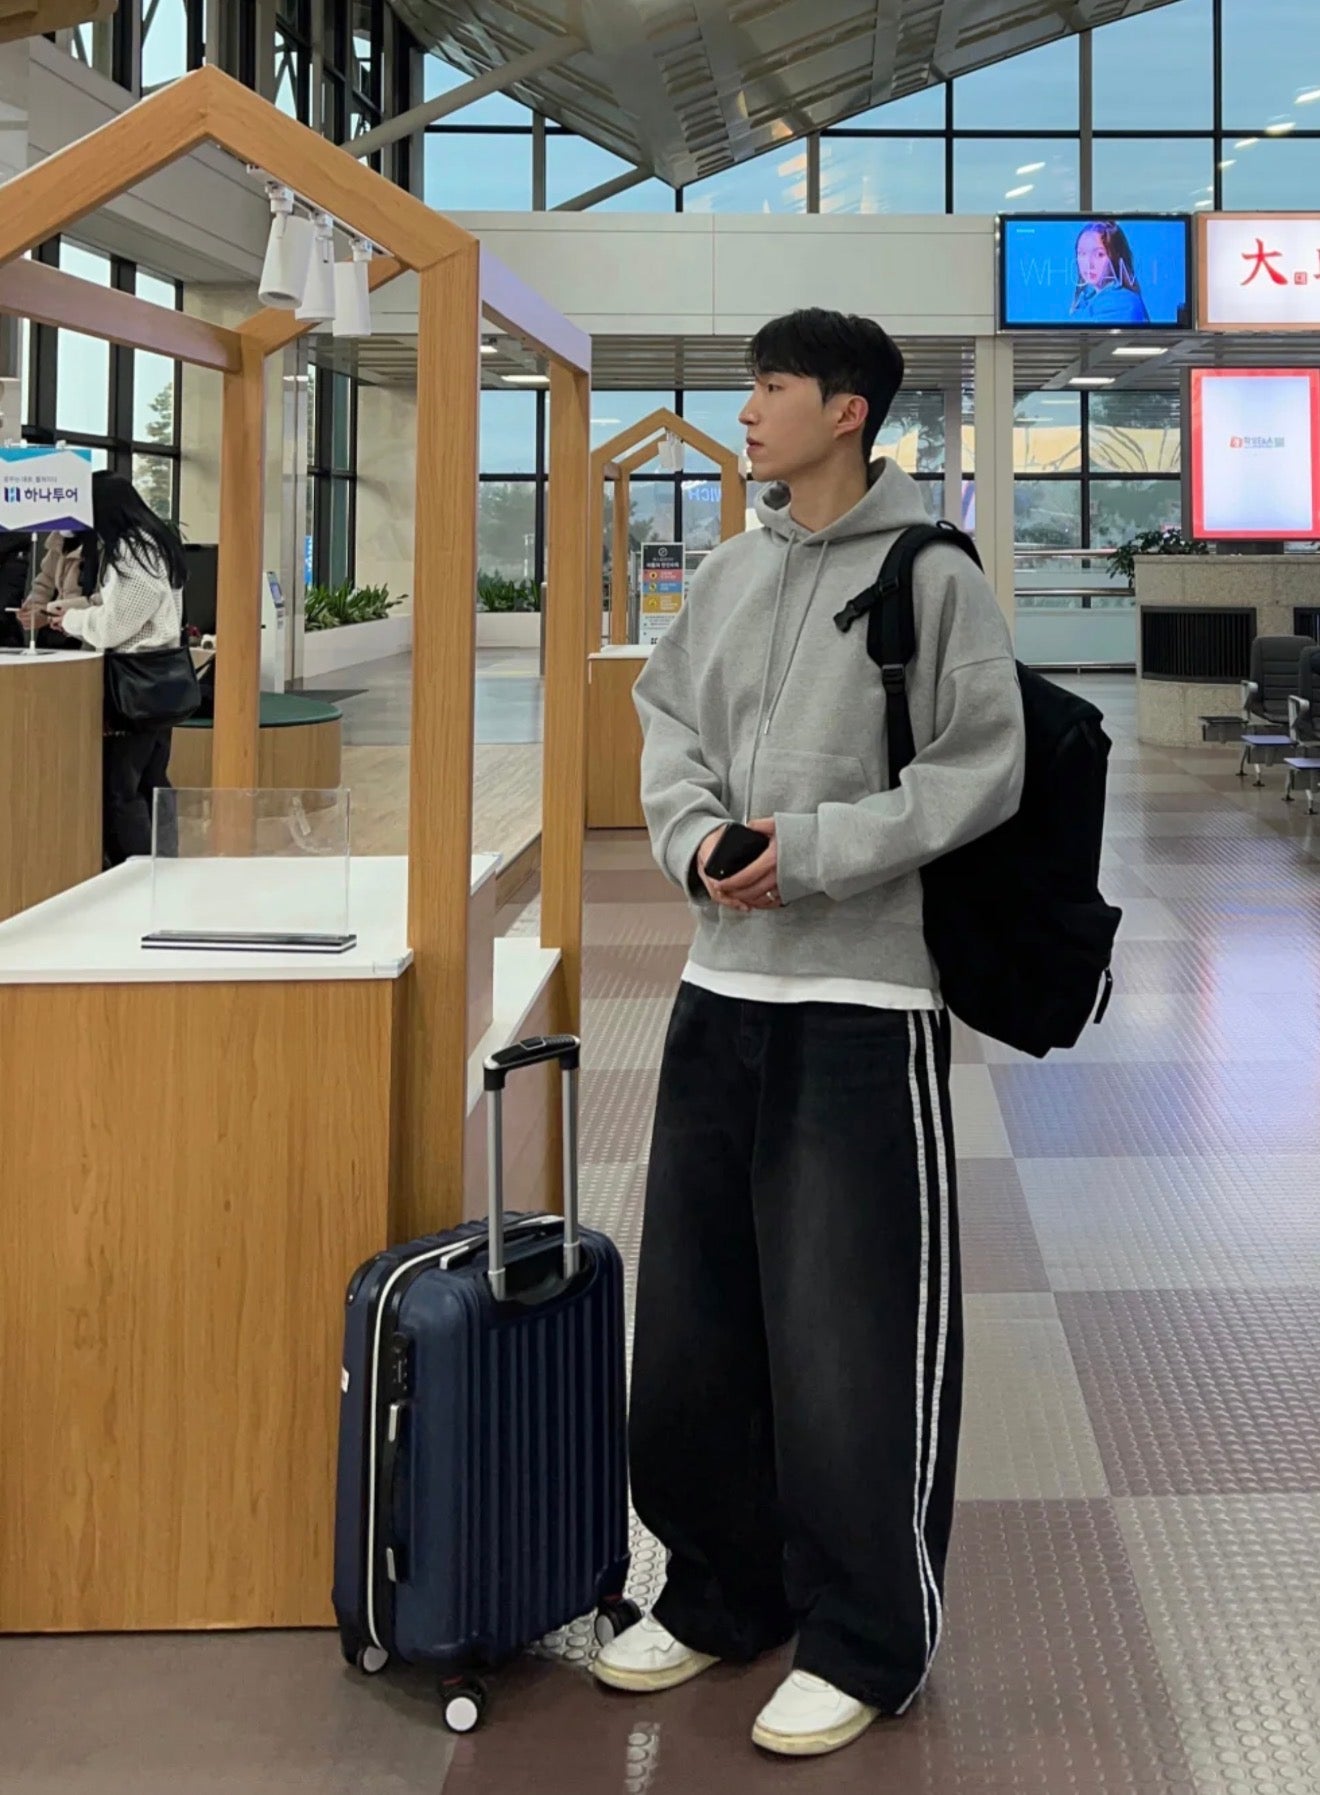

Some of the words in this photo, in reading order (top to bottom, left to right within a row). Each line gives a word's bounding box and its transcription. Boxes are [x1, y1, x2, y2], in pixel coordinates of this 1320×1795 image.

[1020, 257, 1091, 287] WHO
[1100, 257, 1142, 287] AM
[1240, 237, 1288, 286] 大
[24, 487, 78, 503] 하나투어
